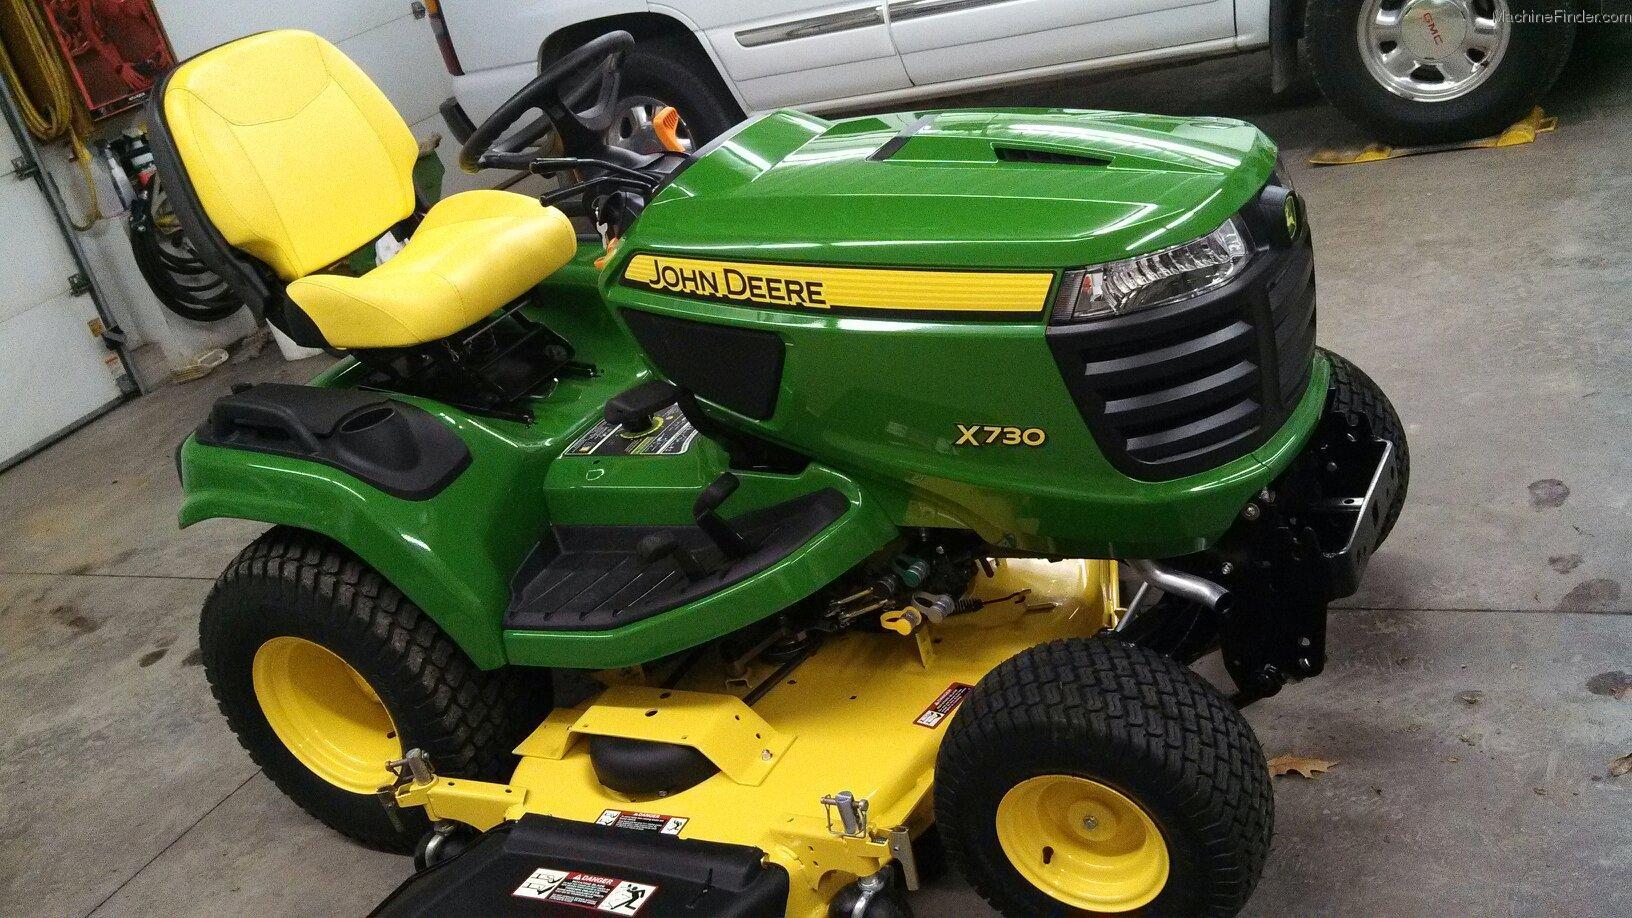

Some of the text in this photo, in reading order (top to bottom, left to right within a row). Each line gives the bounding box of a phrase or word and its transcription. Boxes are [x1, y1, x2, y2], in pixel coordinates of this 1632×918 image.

[1423, 12, 1444, 45] GMC
[649, 259, 828, 305] JOHN DEERE
[954, 424, 1046, 447] X730
[581, 875, 614, 885] DANGER
